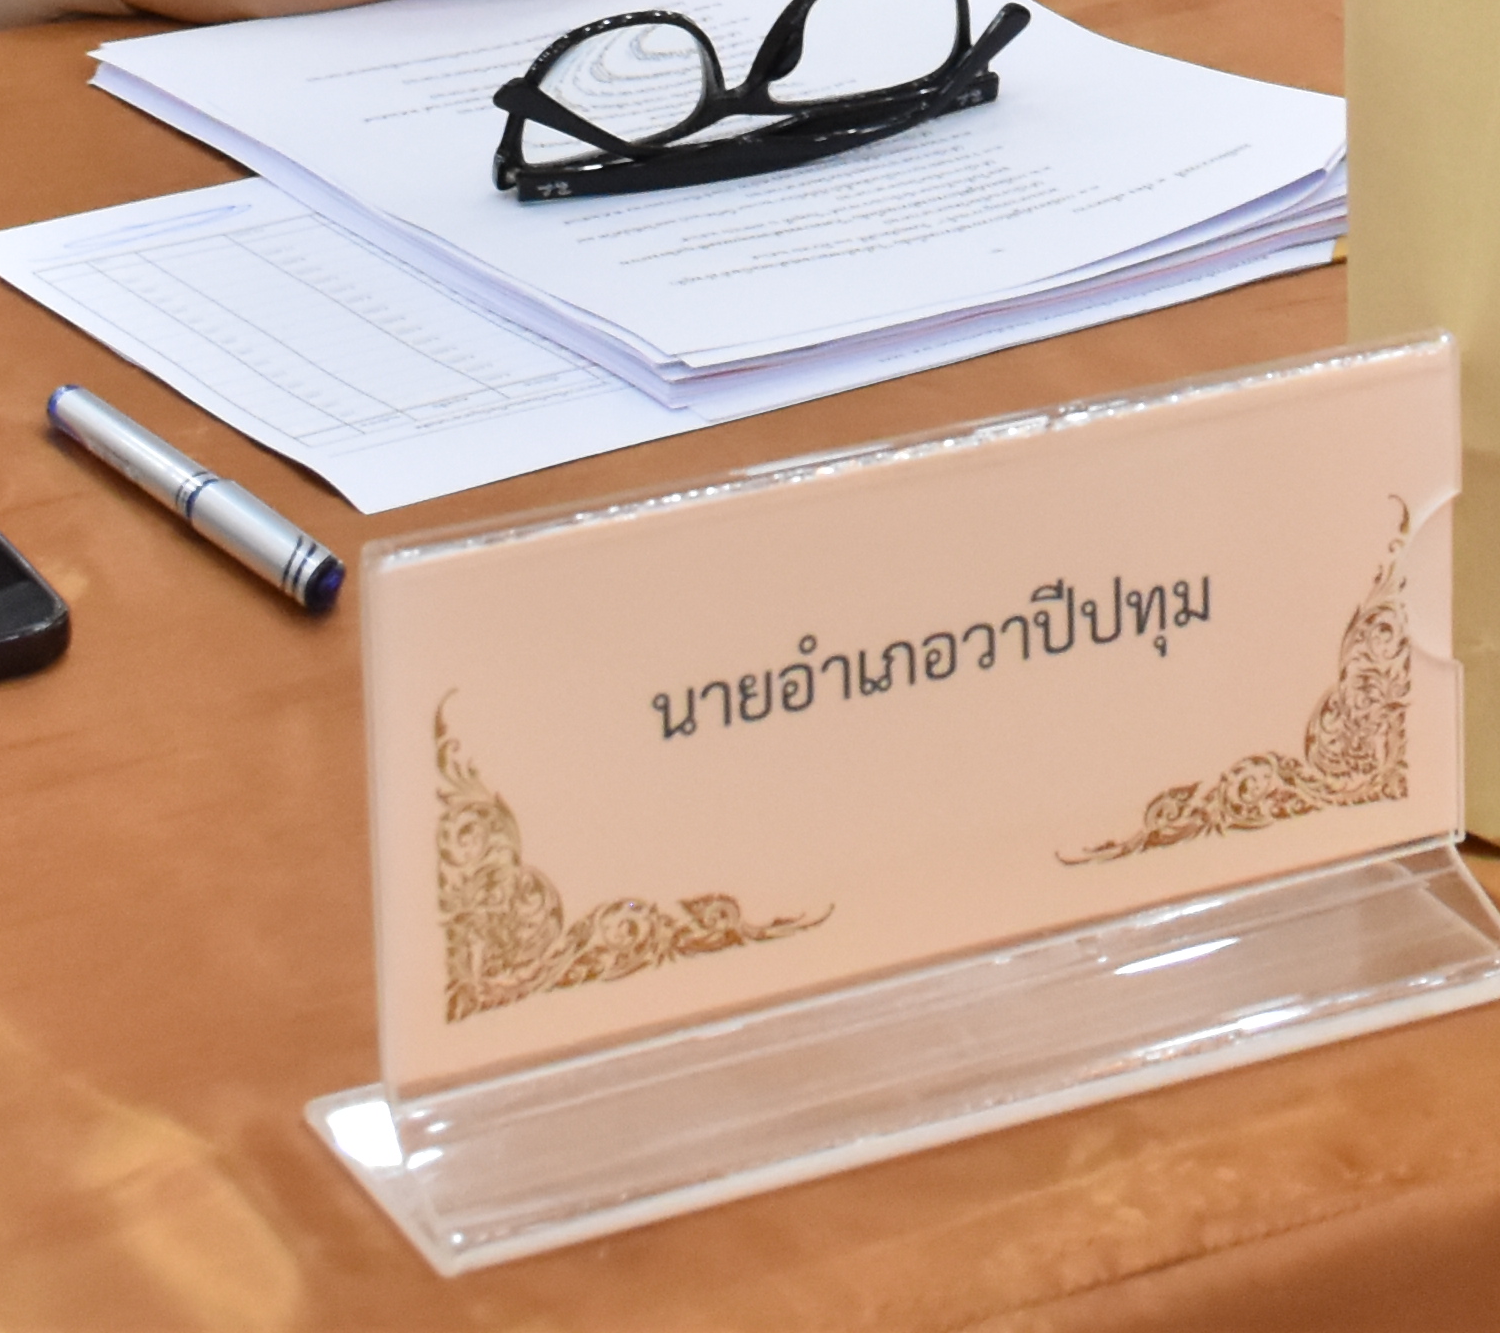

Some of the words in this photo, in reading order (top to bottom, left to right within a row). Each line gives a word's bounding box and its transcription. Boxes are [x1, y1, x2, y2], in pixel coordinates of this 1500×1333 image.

[648, 573, 1213, 742] นายอำเภอวาปีปทุม
